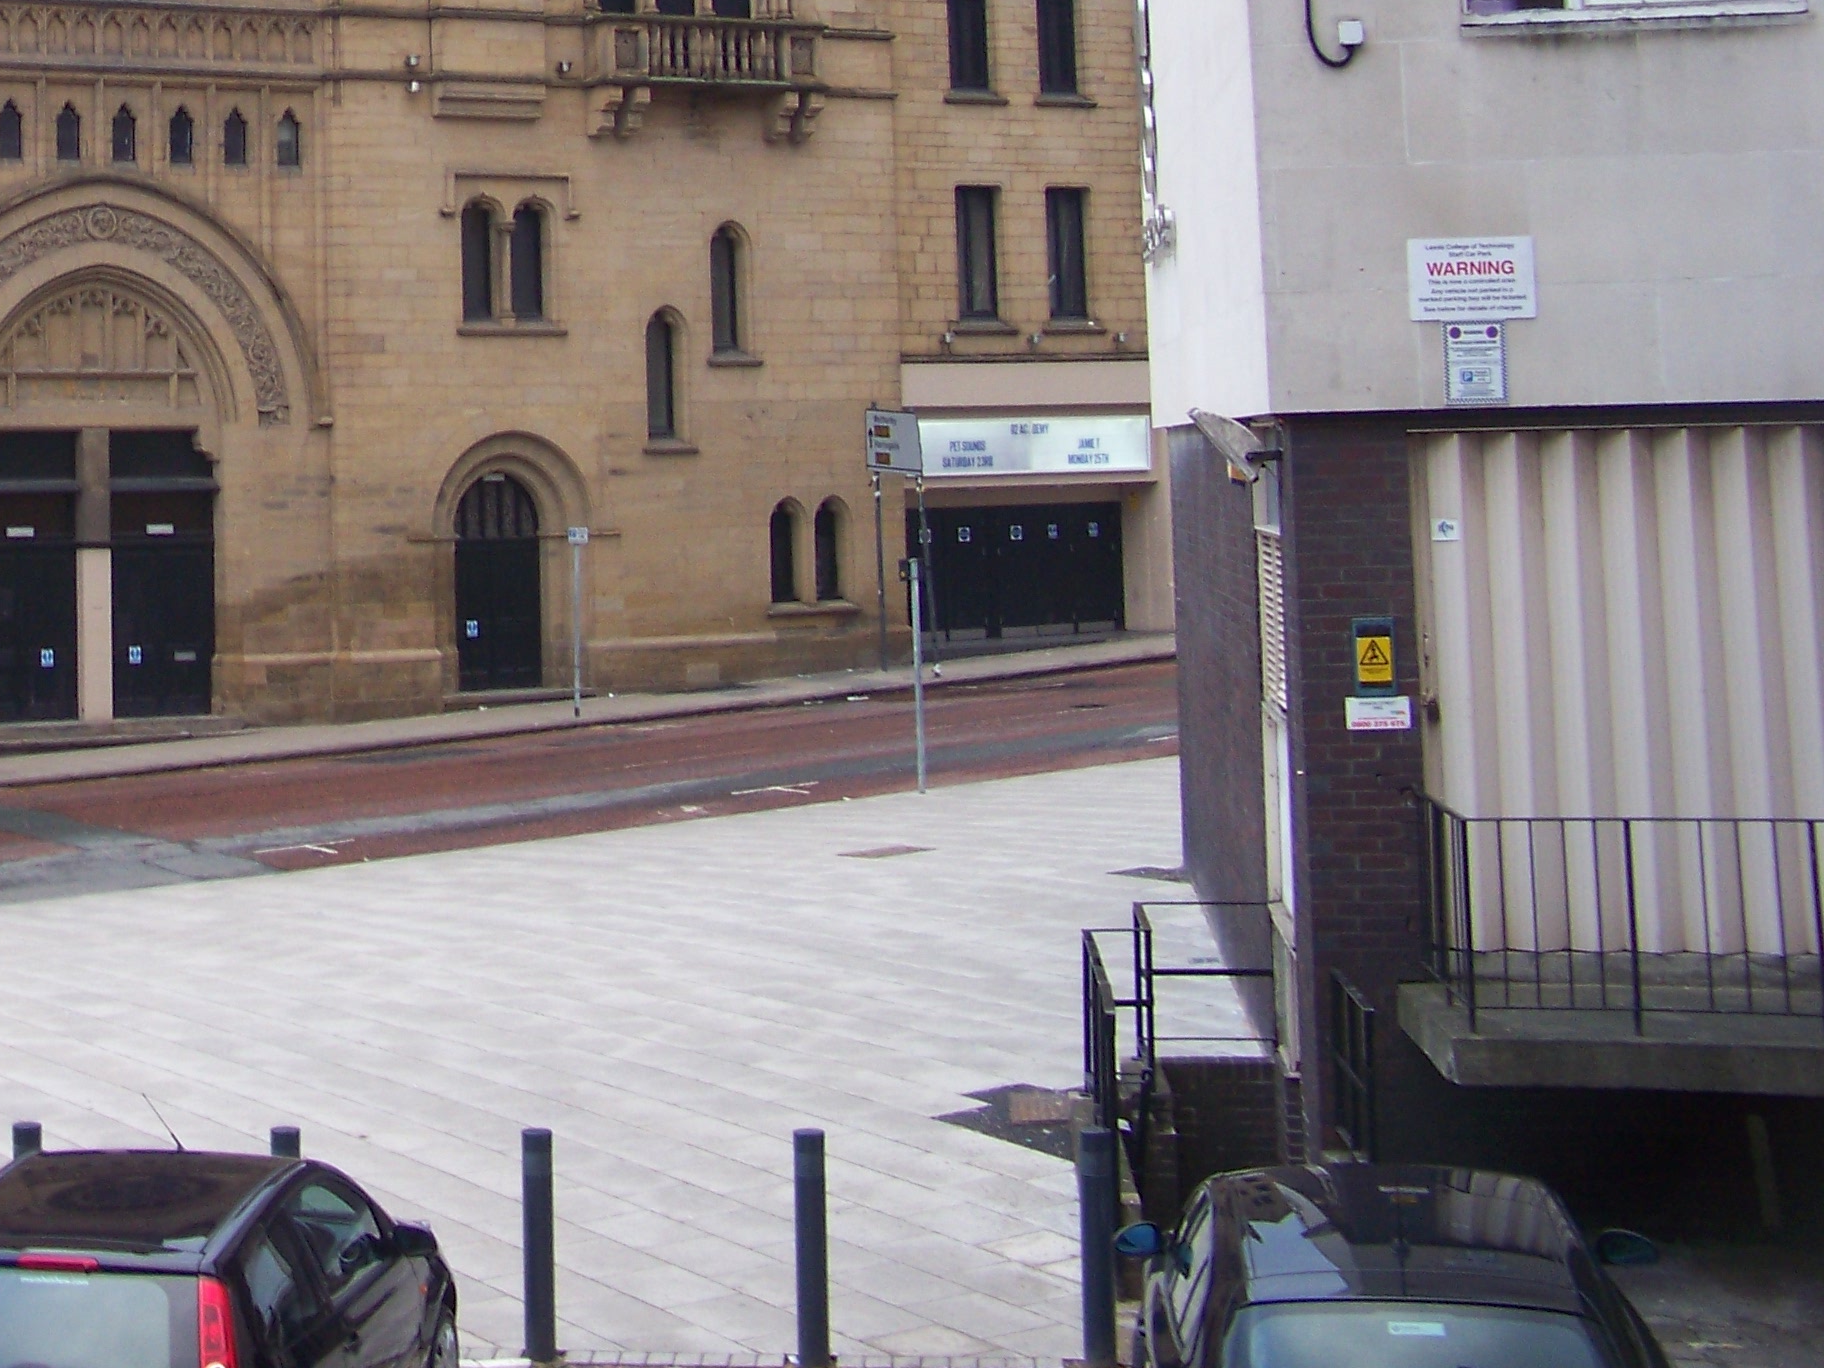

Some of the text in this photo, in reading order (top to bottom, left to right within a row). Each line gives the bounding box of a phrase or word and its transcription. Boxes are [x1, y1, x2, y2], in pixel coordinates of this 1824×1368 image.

[1426, 260, 1515, 276] WARNING
[1019, 423, 1049, 435] ACDEMY
[949, 440, 986, 452] PET SOUNDS
[942, 457, 975, 468] SATURDAY
[1068, 454, 1092, 465] MONDAY
